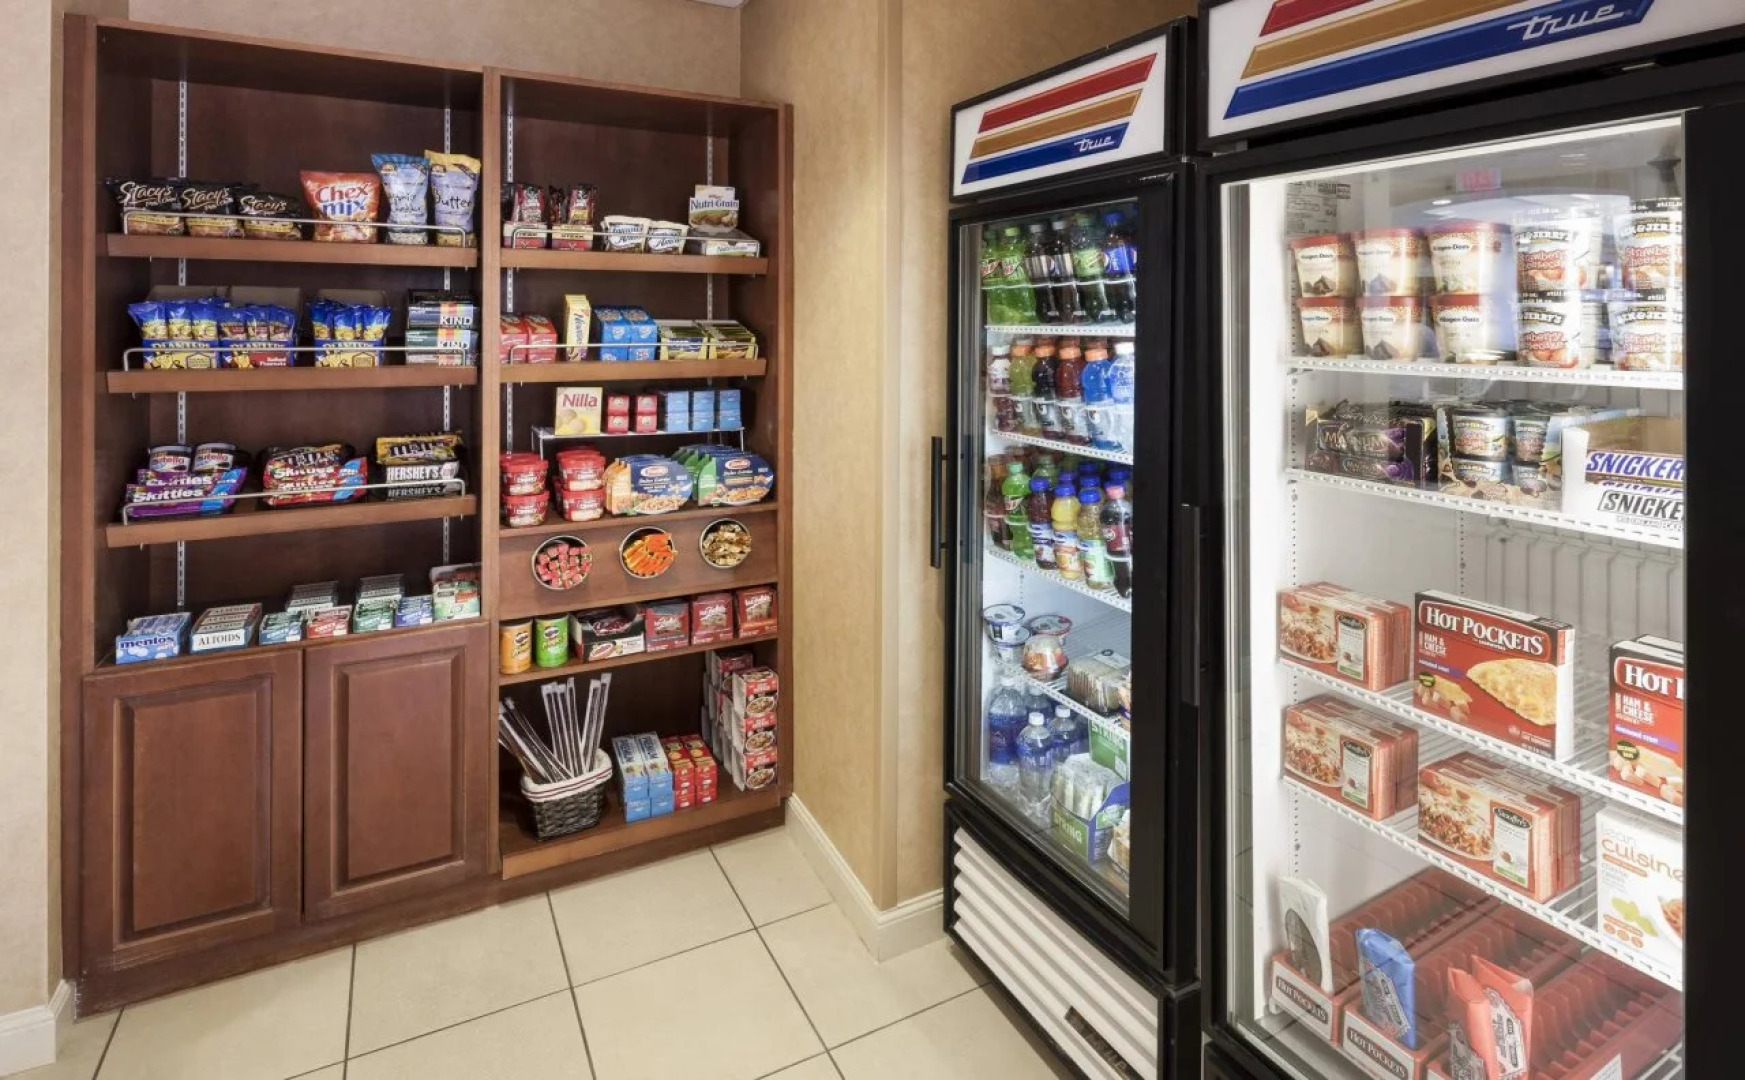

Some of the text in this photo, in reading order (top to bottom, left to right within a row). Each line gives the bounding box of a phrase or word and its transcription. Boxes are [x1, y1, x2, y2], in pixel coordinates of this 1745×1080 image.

[1507, 4, 1624, 40] true
[1074, 135, 1115, 152] true
[119, 181, 174, 205] Stacy's
[181, 188, 231, 209] Stacy's
[315, 184, 369, 203] Chex
[240, 195, 288, 214] Stacy's
[322, 199, 367, 216] mix
[440, 315, 473, 326] KIND
[562, 393, 598, 408] Nilla
[386, 465, 440, 482] HERSHEY'S
[1586, 452, 1684, 480] SNICKER
[132, 489, 205, 503] Skittles
[387, 486, 441, 498] HERSHEY'S
[1603, 492, 1684, 520] SNICKE
[198, 633, 242, 646] ALTOIDS
[1424, 632, 1438, 643] HAM
[1426, 606, 1544, 656] HOT POCKETS
[119, 636, 175, 649] mentos
[1424, 641, 1447, 656] CHEESE
[1624, 663, 1672, 695] HOT
[1623, 694, 1641, 709] HAM
[1622, 706, 1655, 724] CHEESE
[1277, 976, 1328, 1023] HOT POCKETS
[1349, 1027, 1408, 1079] HOT POCKETS
